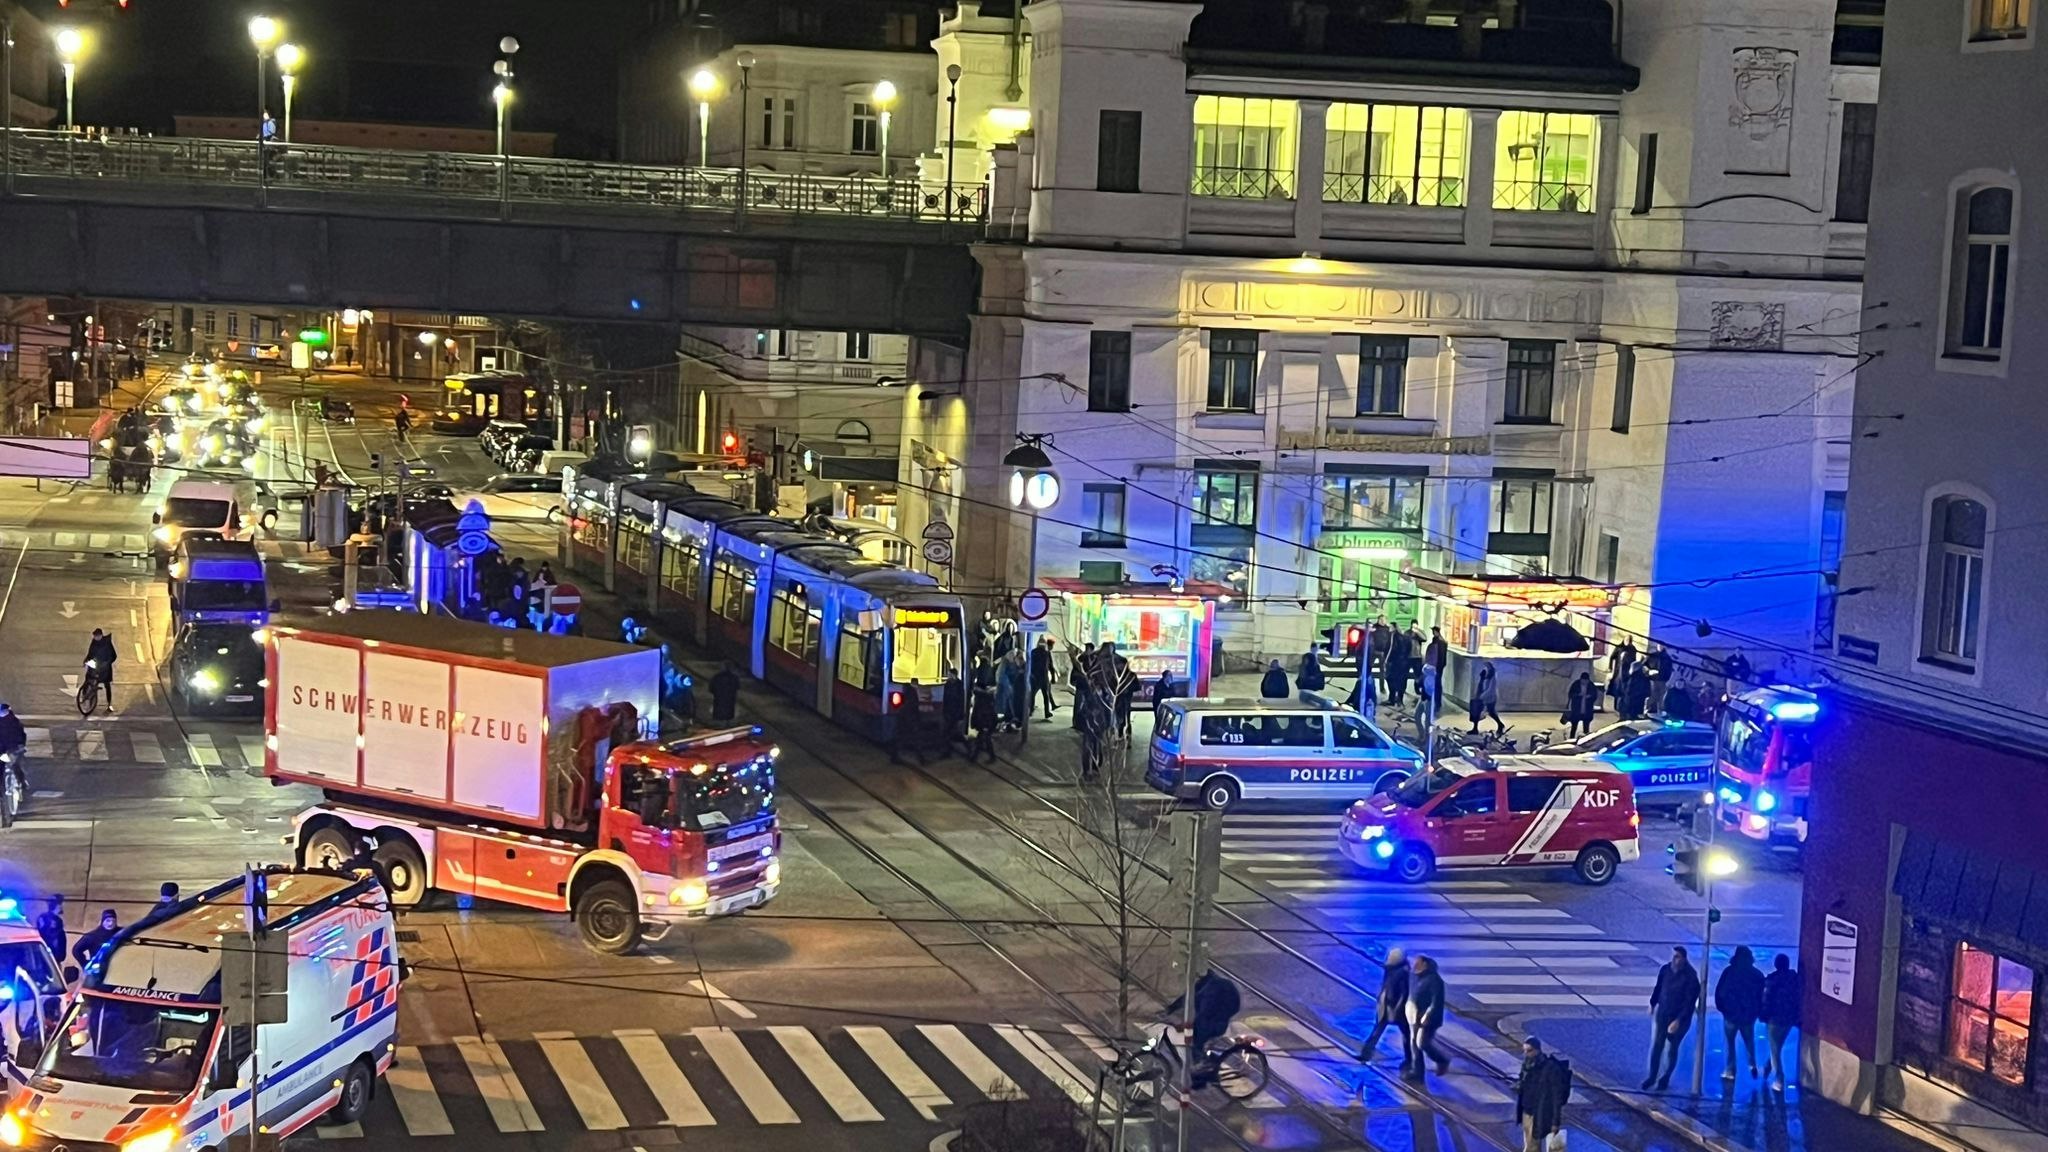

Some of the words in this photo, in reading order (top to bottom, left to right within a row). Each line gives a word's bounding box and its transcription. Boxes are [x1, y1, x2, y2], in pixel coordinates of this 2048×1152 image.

[1290, 768, 1354, 781] POLIZEI
[1651, 771, 1698, 784] POLIZEI
[1583, 789, 1620, 808] KDF
[112, 986, 181, 1002] AMBULANCE
